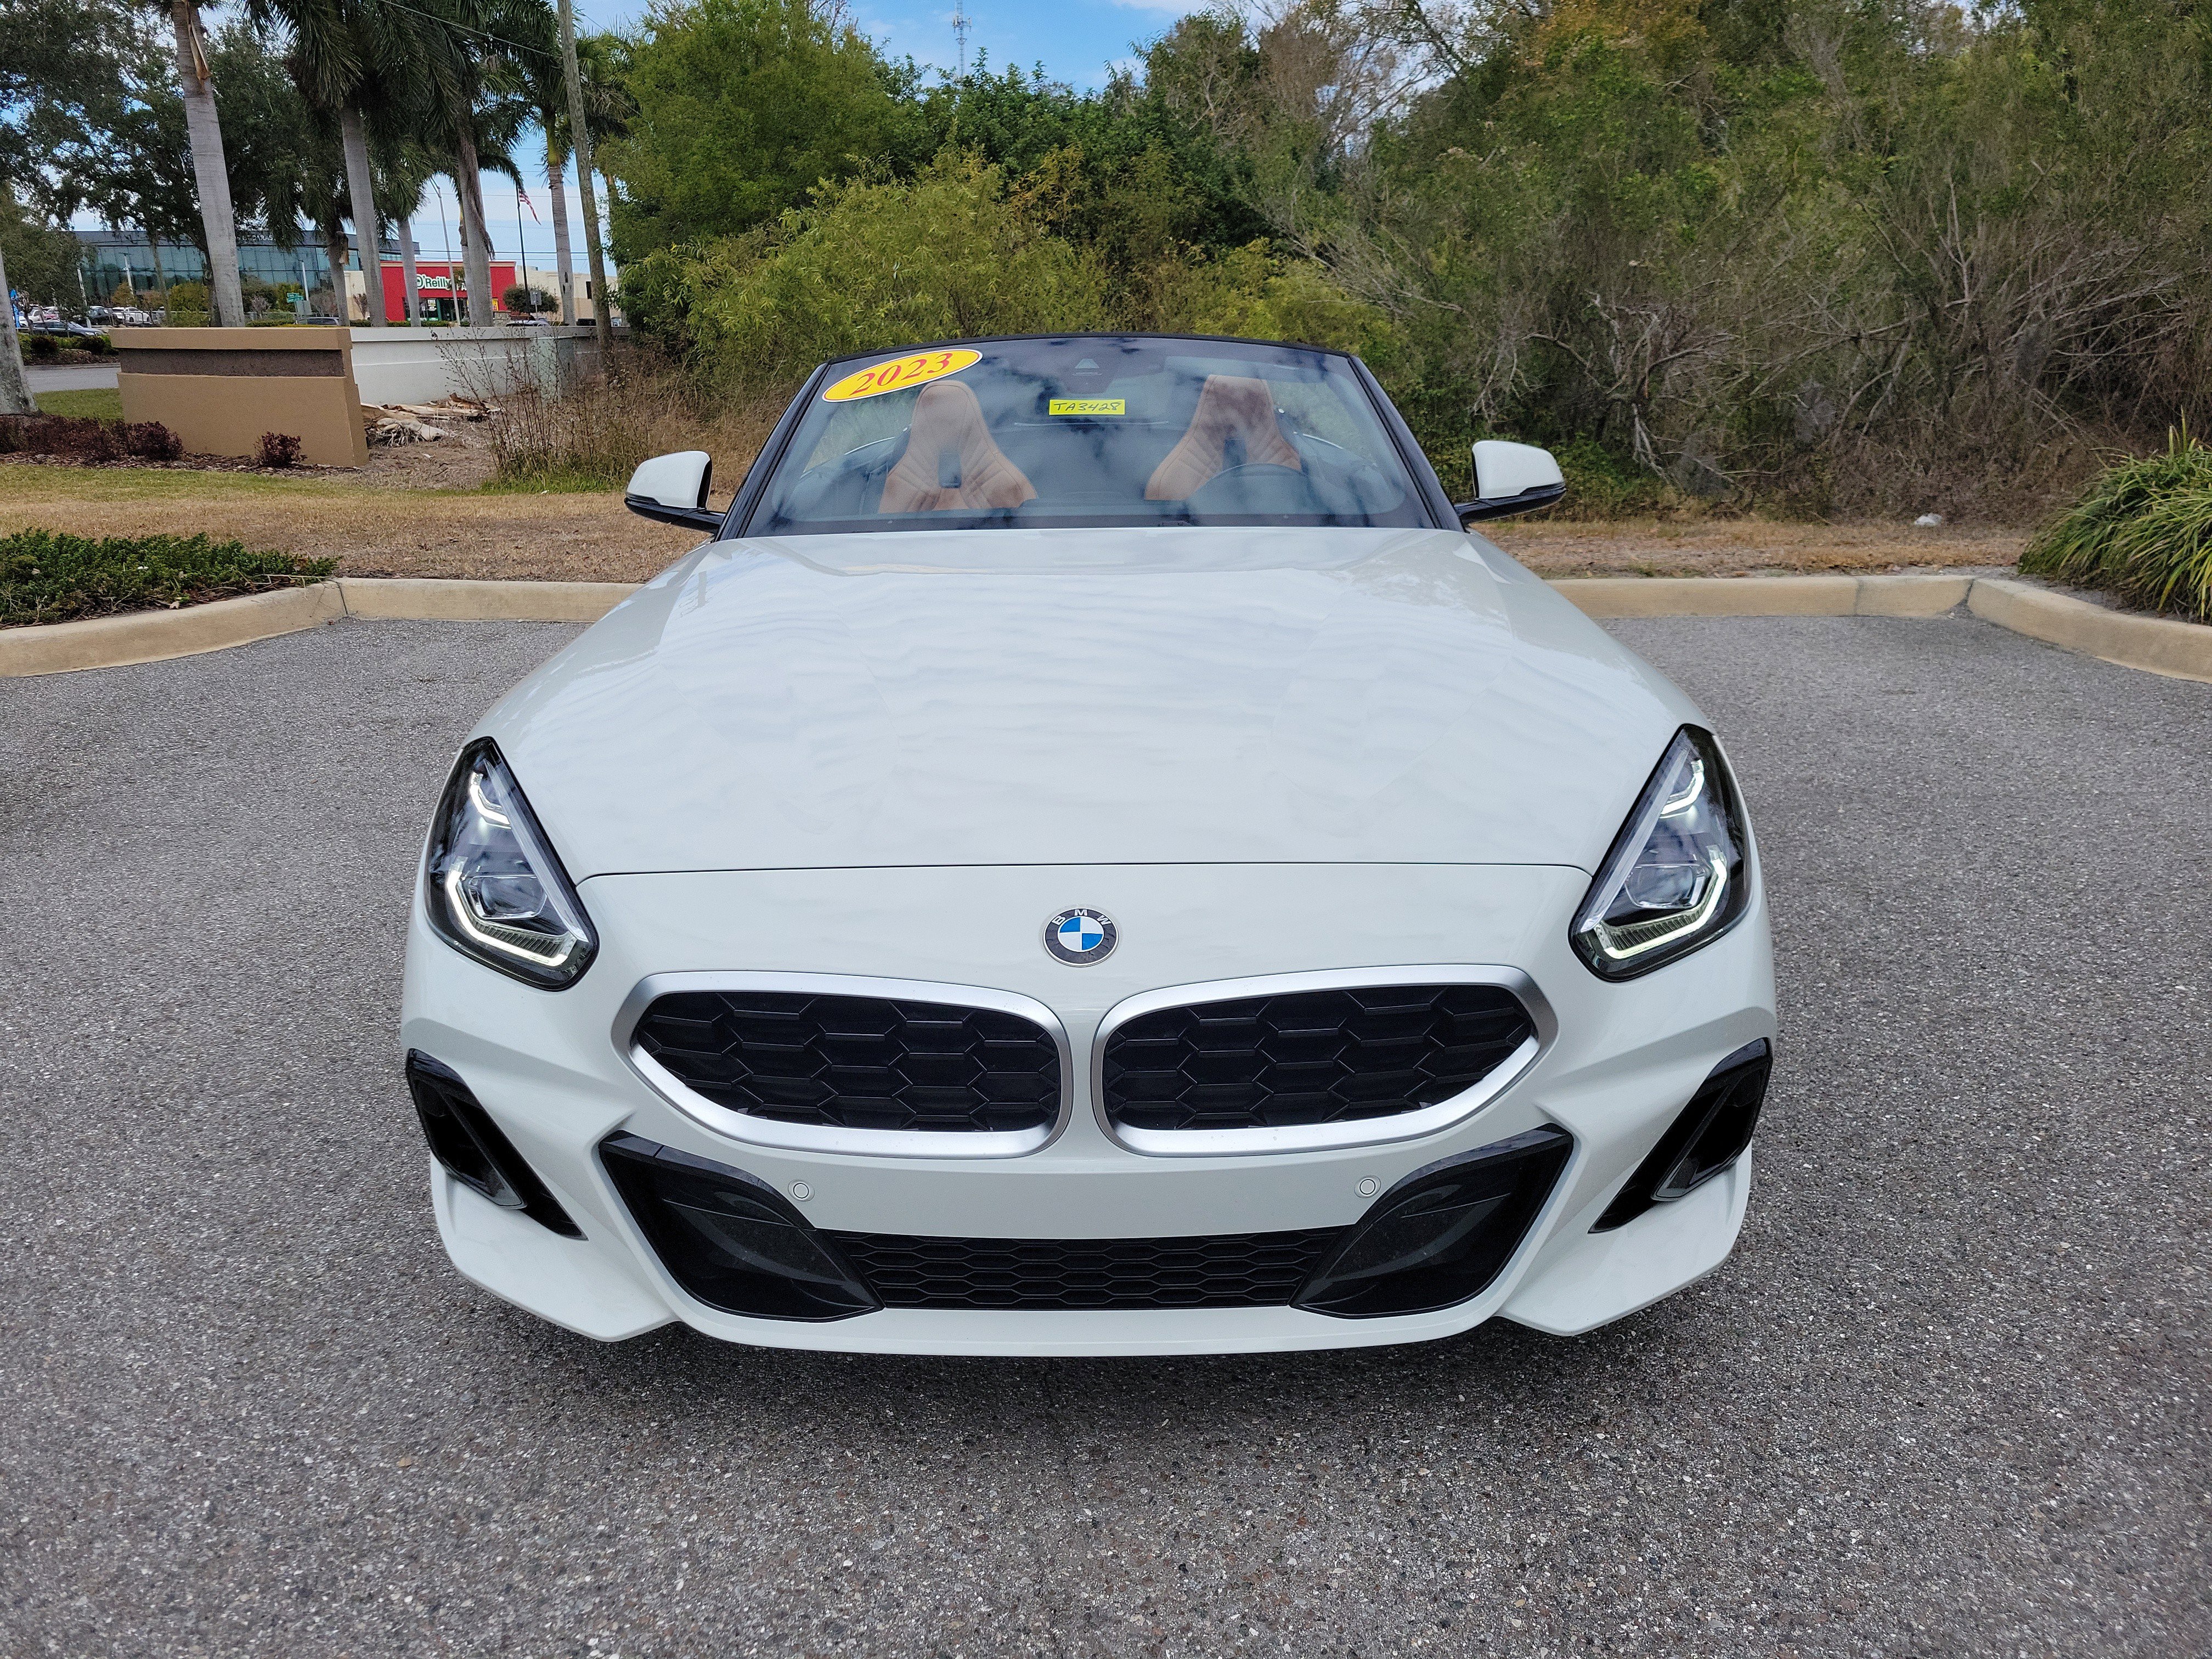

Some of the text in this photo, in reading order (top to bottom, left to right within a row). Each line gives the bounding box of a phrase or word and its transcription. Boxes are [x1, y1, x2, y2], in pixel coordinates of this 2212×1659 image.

[849, 353, 953, 396] 2023
[1053, 402, 1122, 411] TA3428
[1051, 909, 1112, 926] BMW
